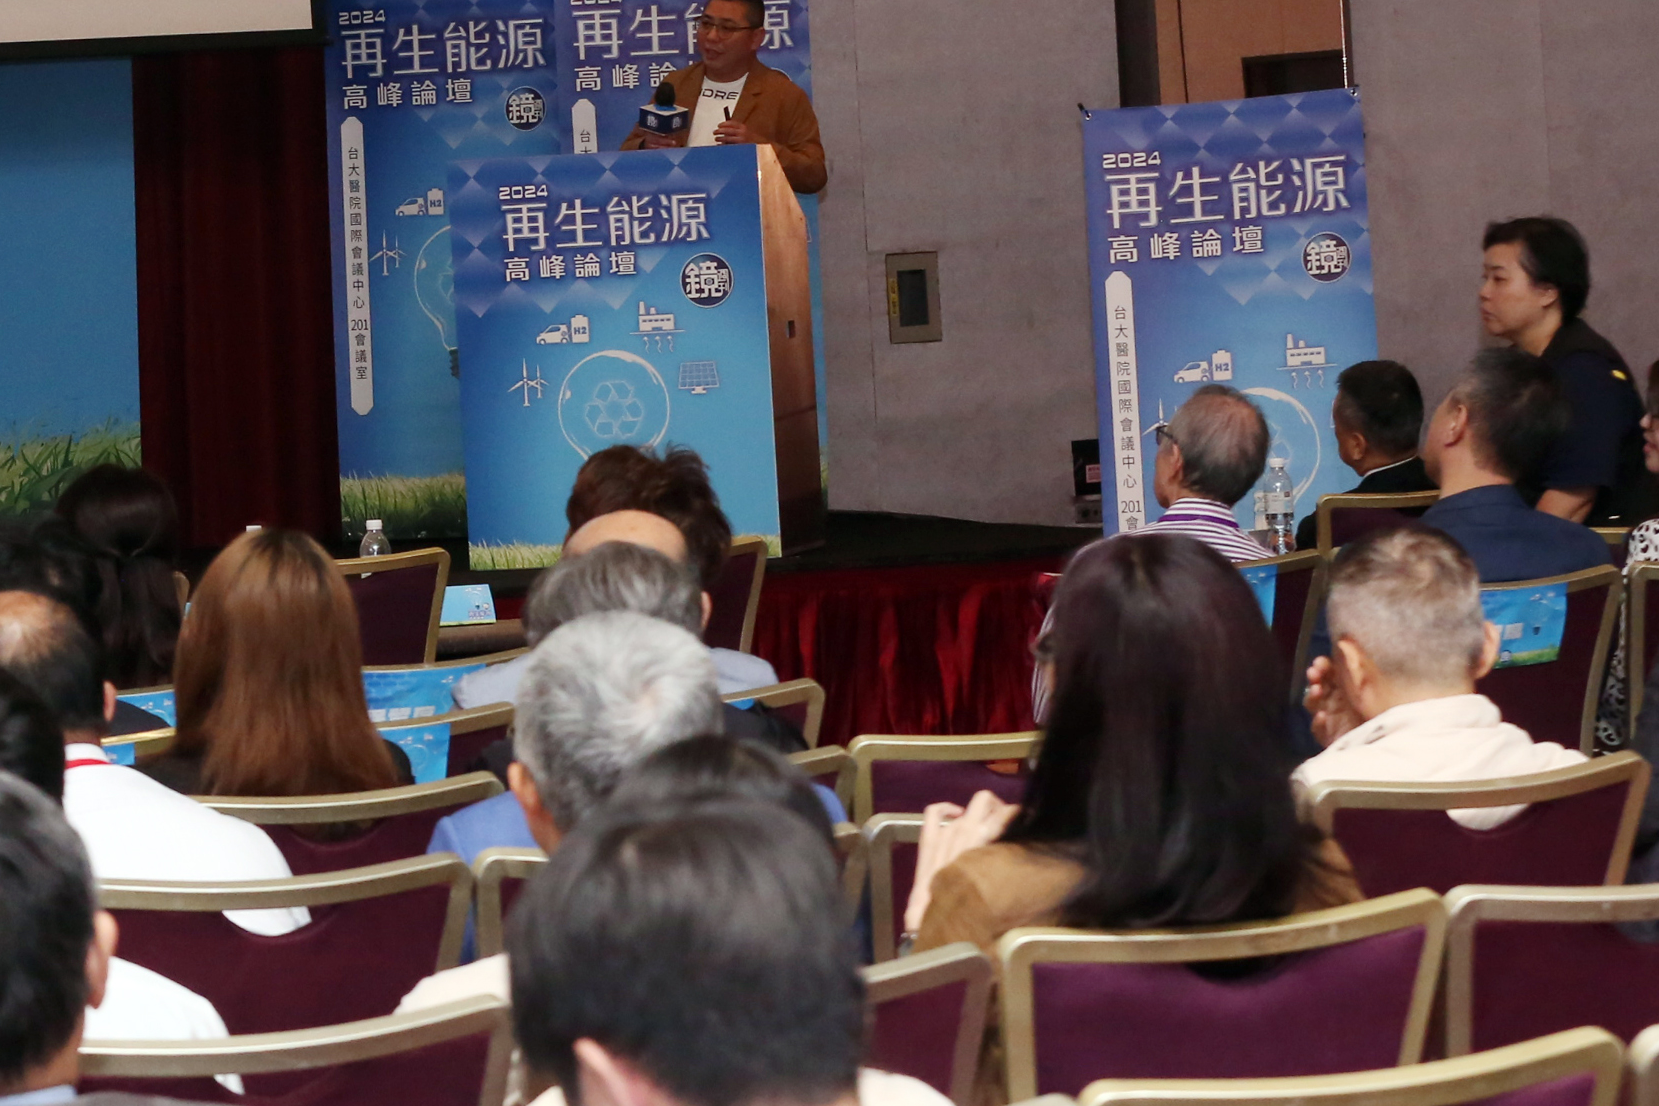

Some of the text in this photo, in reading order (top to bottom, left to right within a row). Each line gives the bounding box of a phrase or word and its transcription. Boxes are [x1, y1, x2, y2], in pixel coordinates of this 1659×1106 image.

[339, 10, 386, 25] 2024
[341, 18, 547, 80] 再生能源
[342, 78, 473, 110] 高峰論壇
[700, 88, 739, 101] DRE
[1102, 151, 1162, 169] 2024
[498, 184, 548, 200] 2024
[1105, 154, 1351, 230] 再生能源
[500, 192, 711, 252] 再生能源
[1107, 225, 1265, 264] 高峰論壇
[503, 251, 638, 282] 高峰論壇
[573, 326, 587, 335] H2
[1214, 363, 1230, 372] H2
